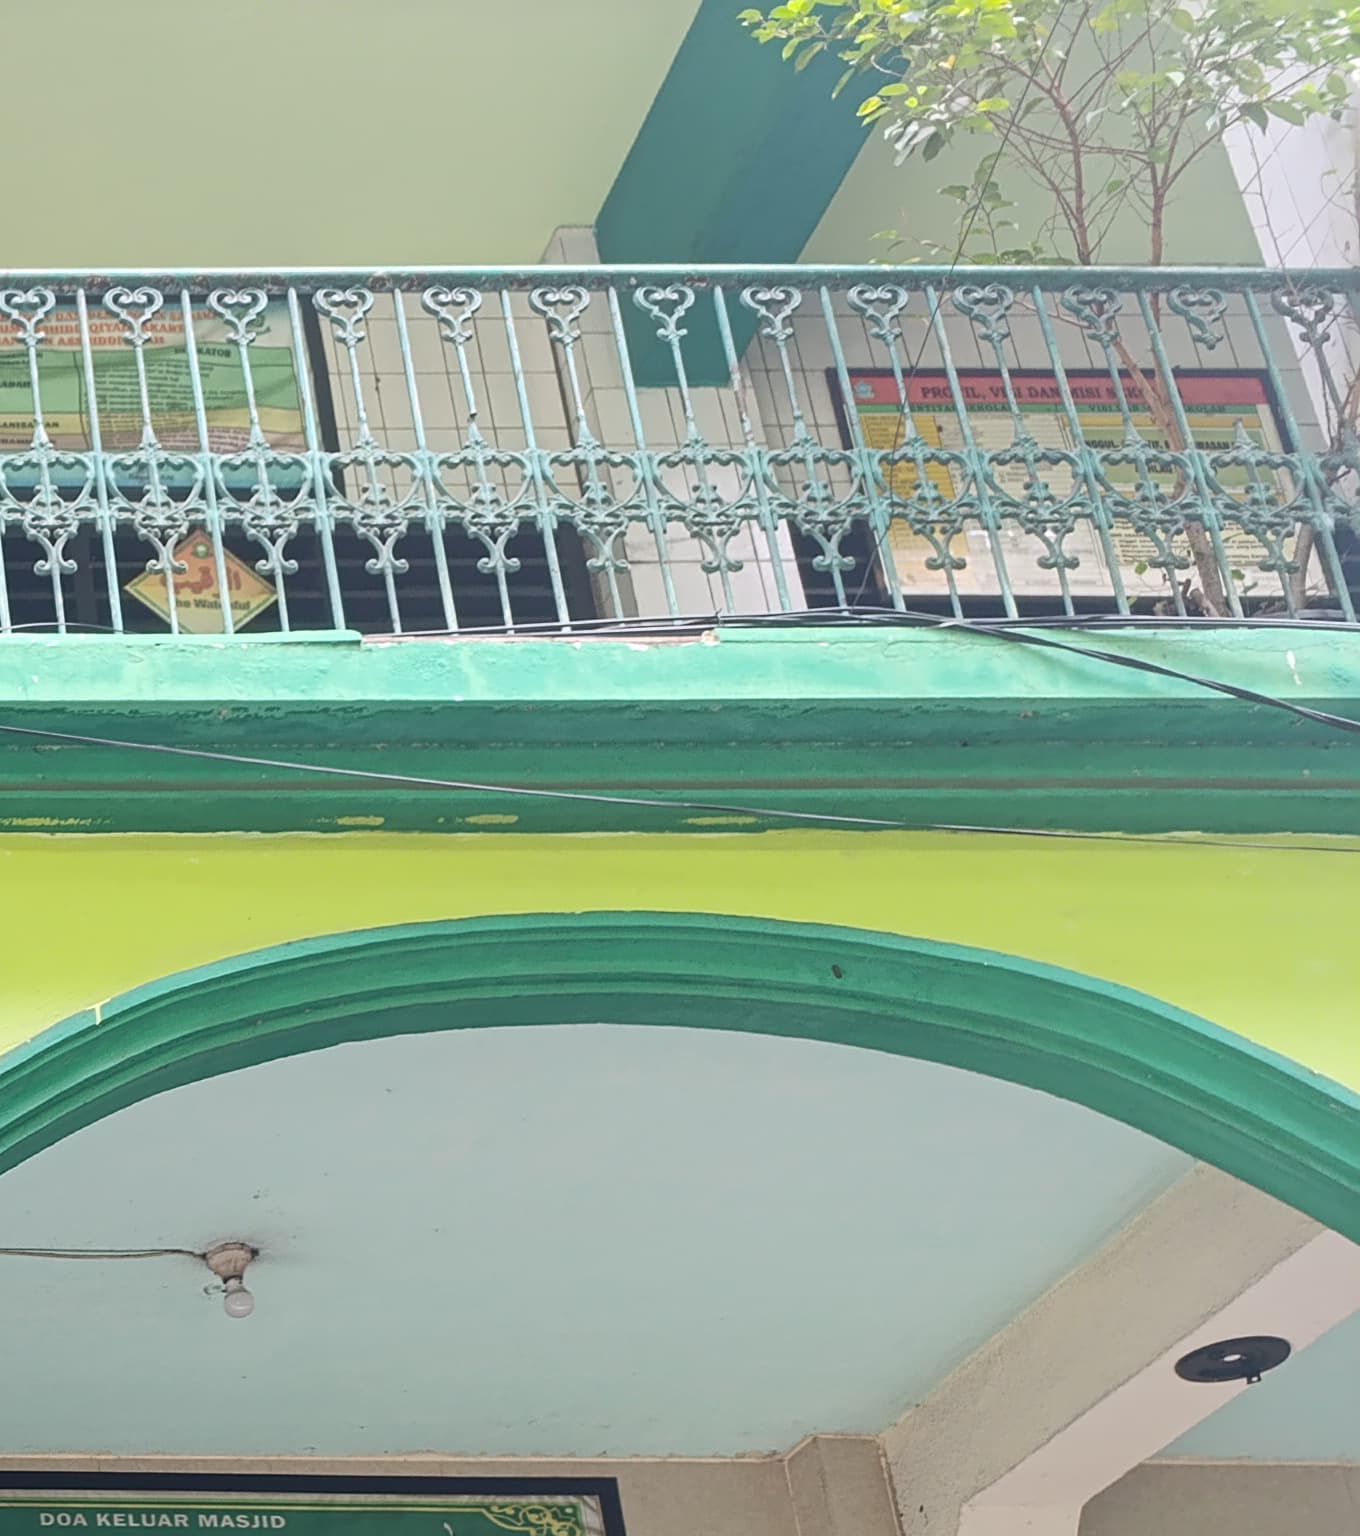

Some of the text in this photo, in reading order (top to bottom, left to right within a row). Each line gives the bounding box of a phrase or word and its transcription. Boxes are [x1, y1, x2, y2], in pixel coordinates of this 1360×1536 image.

[921, 387, 987, 401] PROIL,
[40, 1512, 286, 1530] DOA KELUAR MASJID
